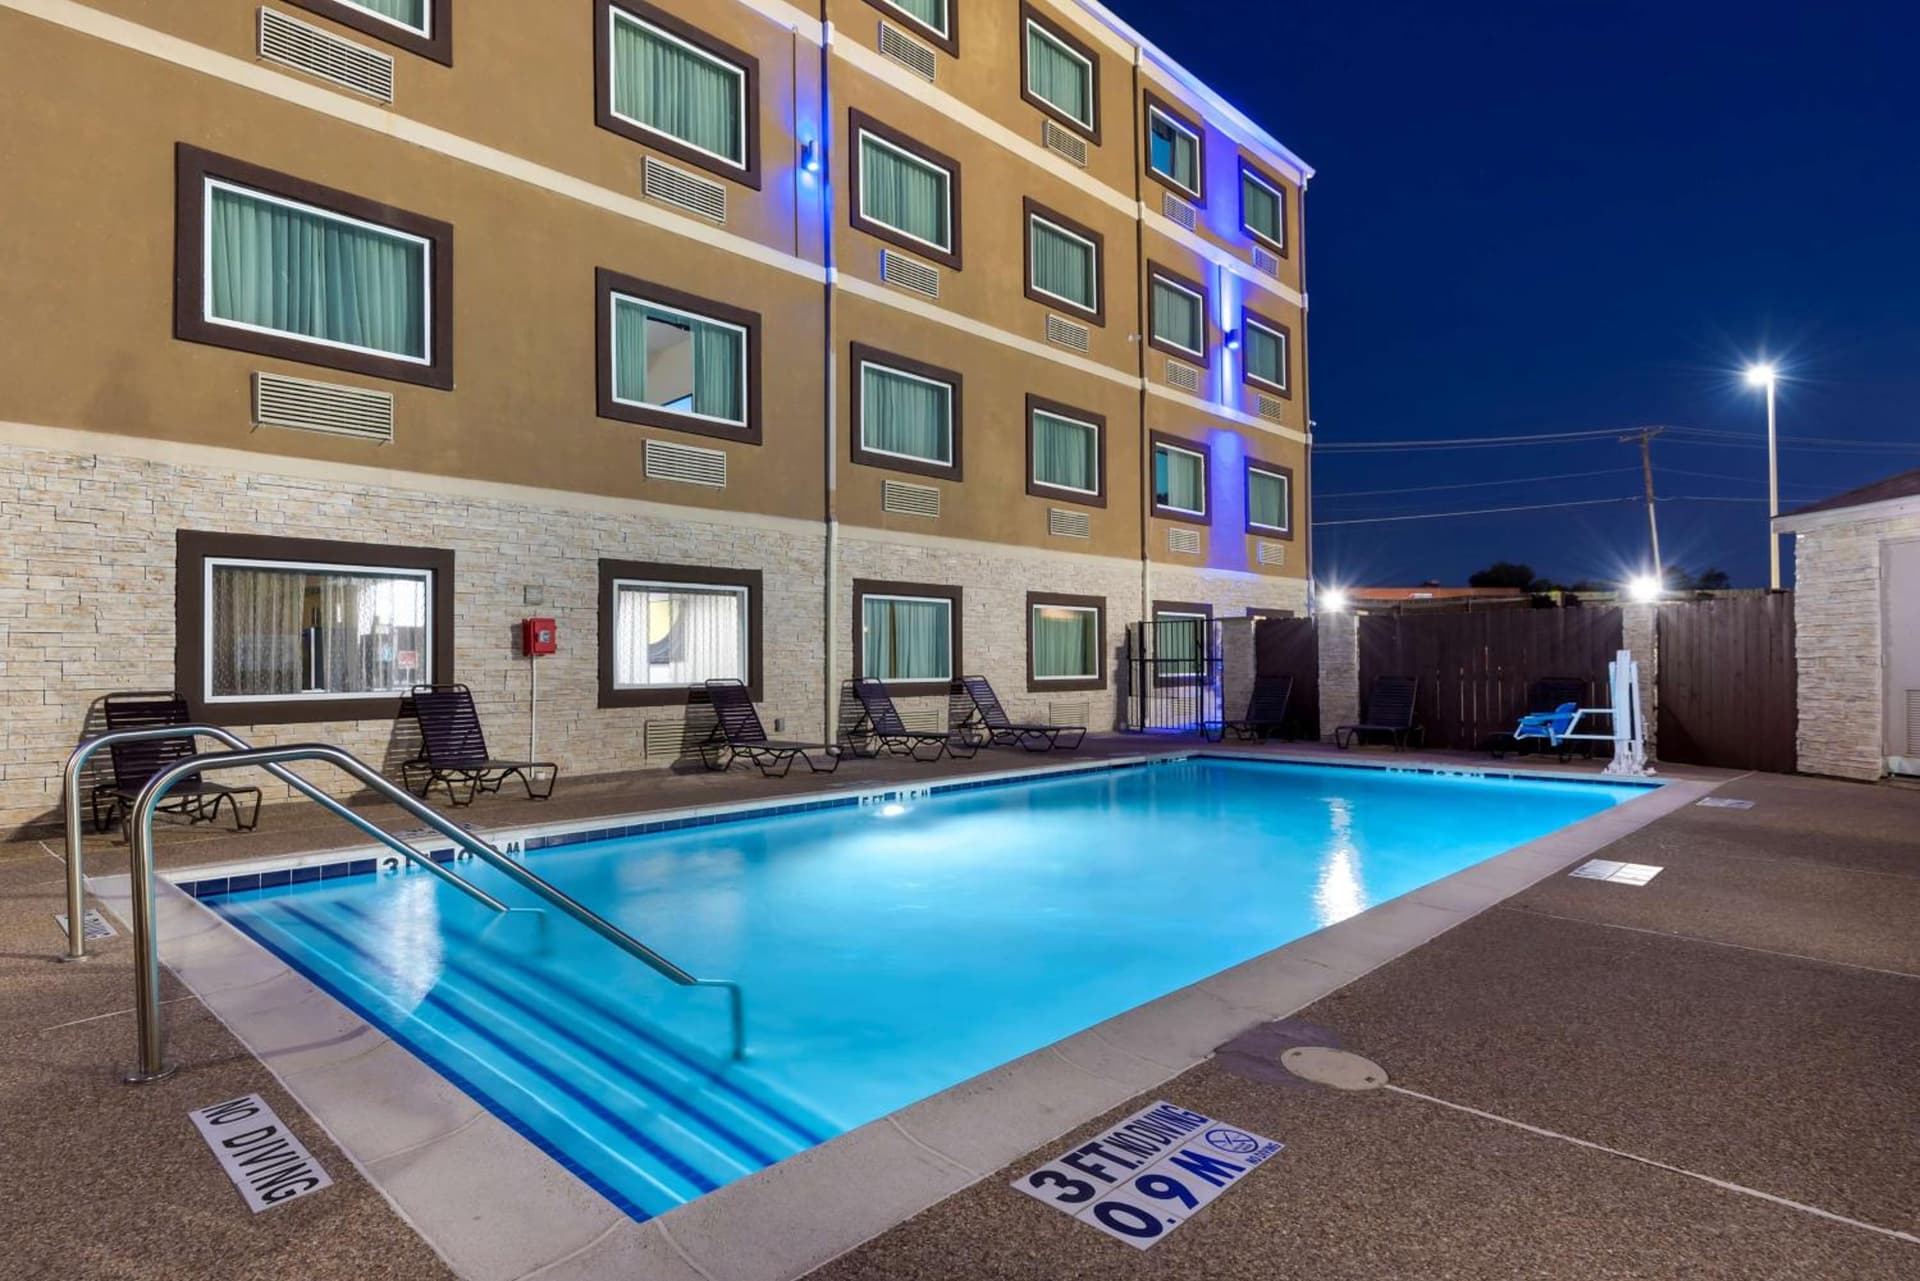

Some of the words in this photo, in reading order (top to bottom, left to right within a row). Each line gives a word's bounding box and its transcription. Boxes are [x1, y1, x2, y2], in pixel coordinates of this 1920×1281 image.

[201, 1097, 260, 1125] NO
[1123, 1104, 1209, 1146] DIVING
[222, 1125, 319, 1205] DIVING
[1102, 1132, 1161, 1159] NO
[1093, 1174, 1200, 1238] 0.9
[1169, 1149, 1247, 1188] M
